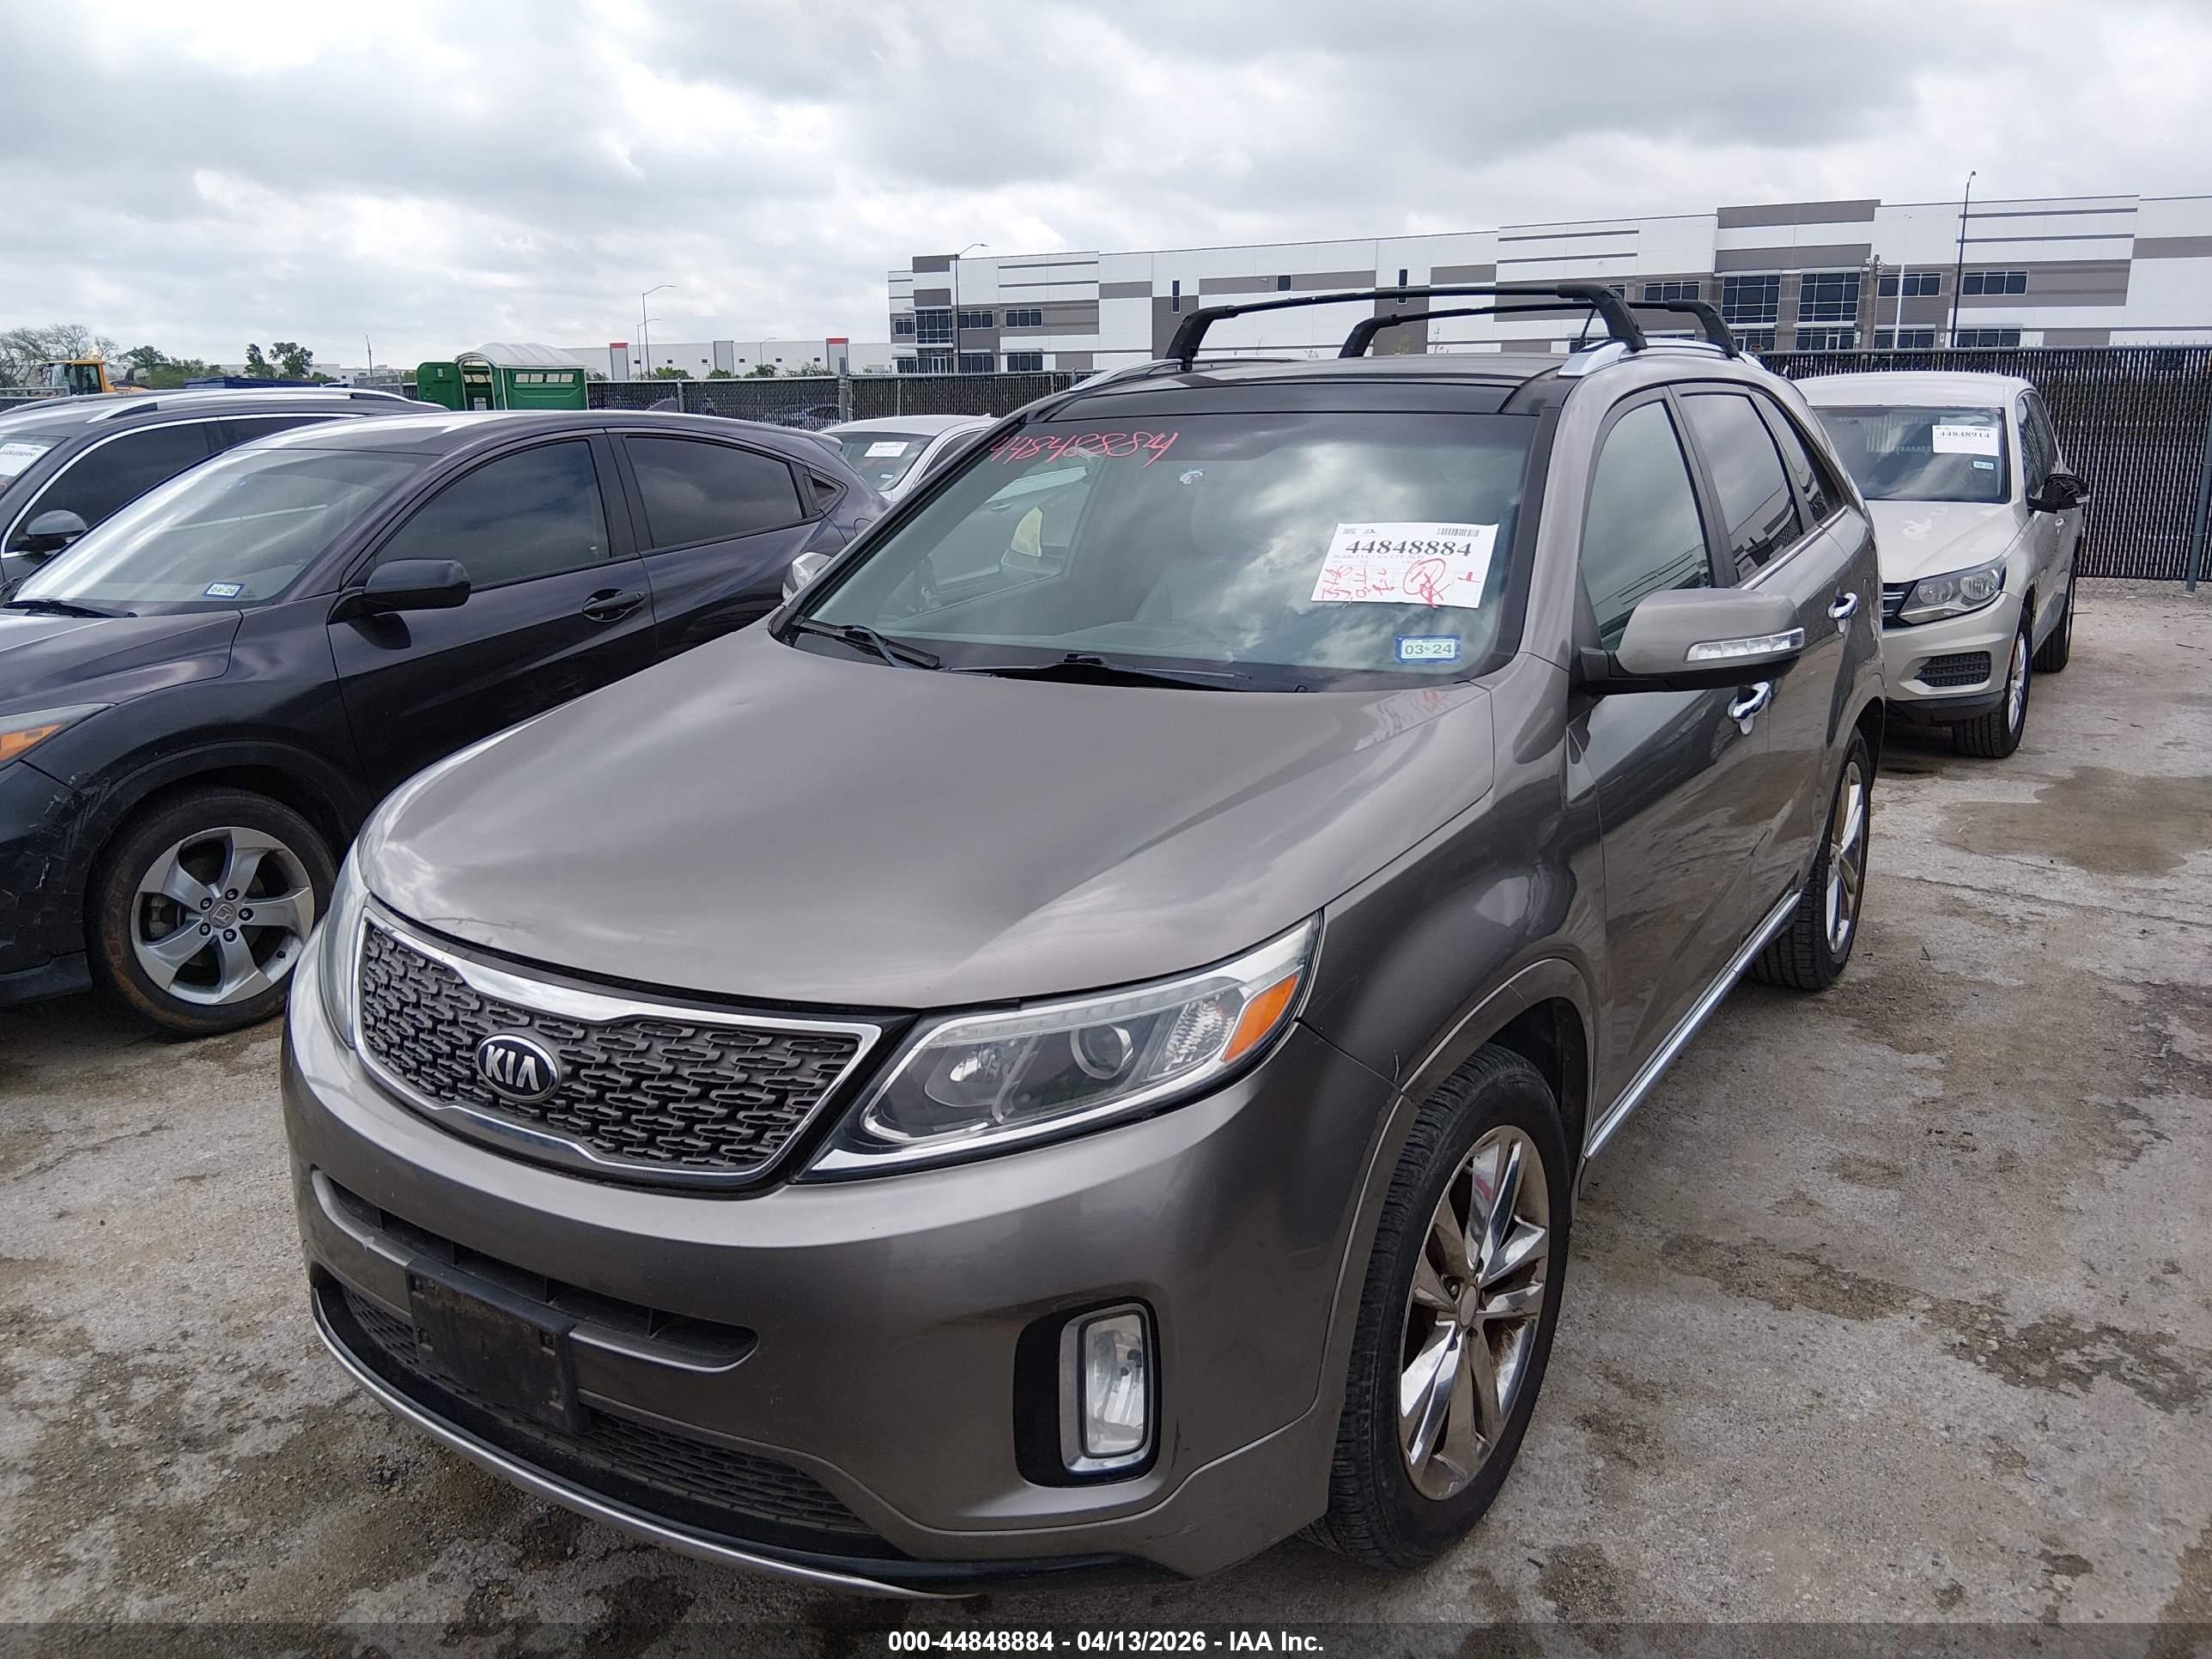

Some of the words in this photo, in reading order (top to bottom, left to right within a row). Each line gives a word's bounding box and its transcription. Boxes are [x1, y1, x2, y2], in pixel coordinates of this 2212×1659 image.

[989, 431, 1179, 469] 44848884
[1345, 539, 1473, 557] 44848884
[1404, 644, 1453, 655] 03-24
[485, 1044, 540, 1091] KIA
